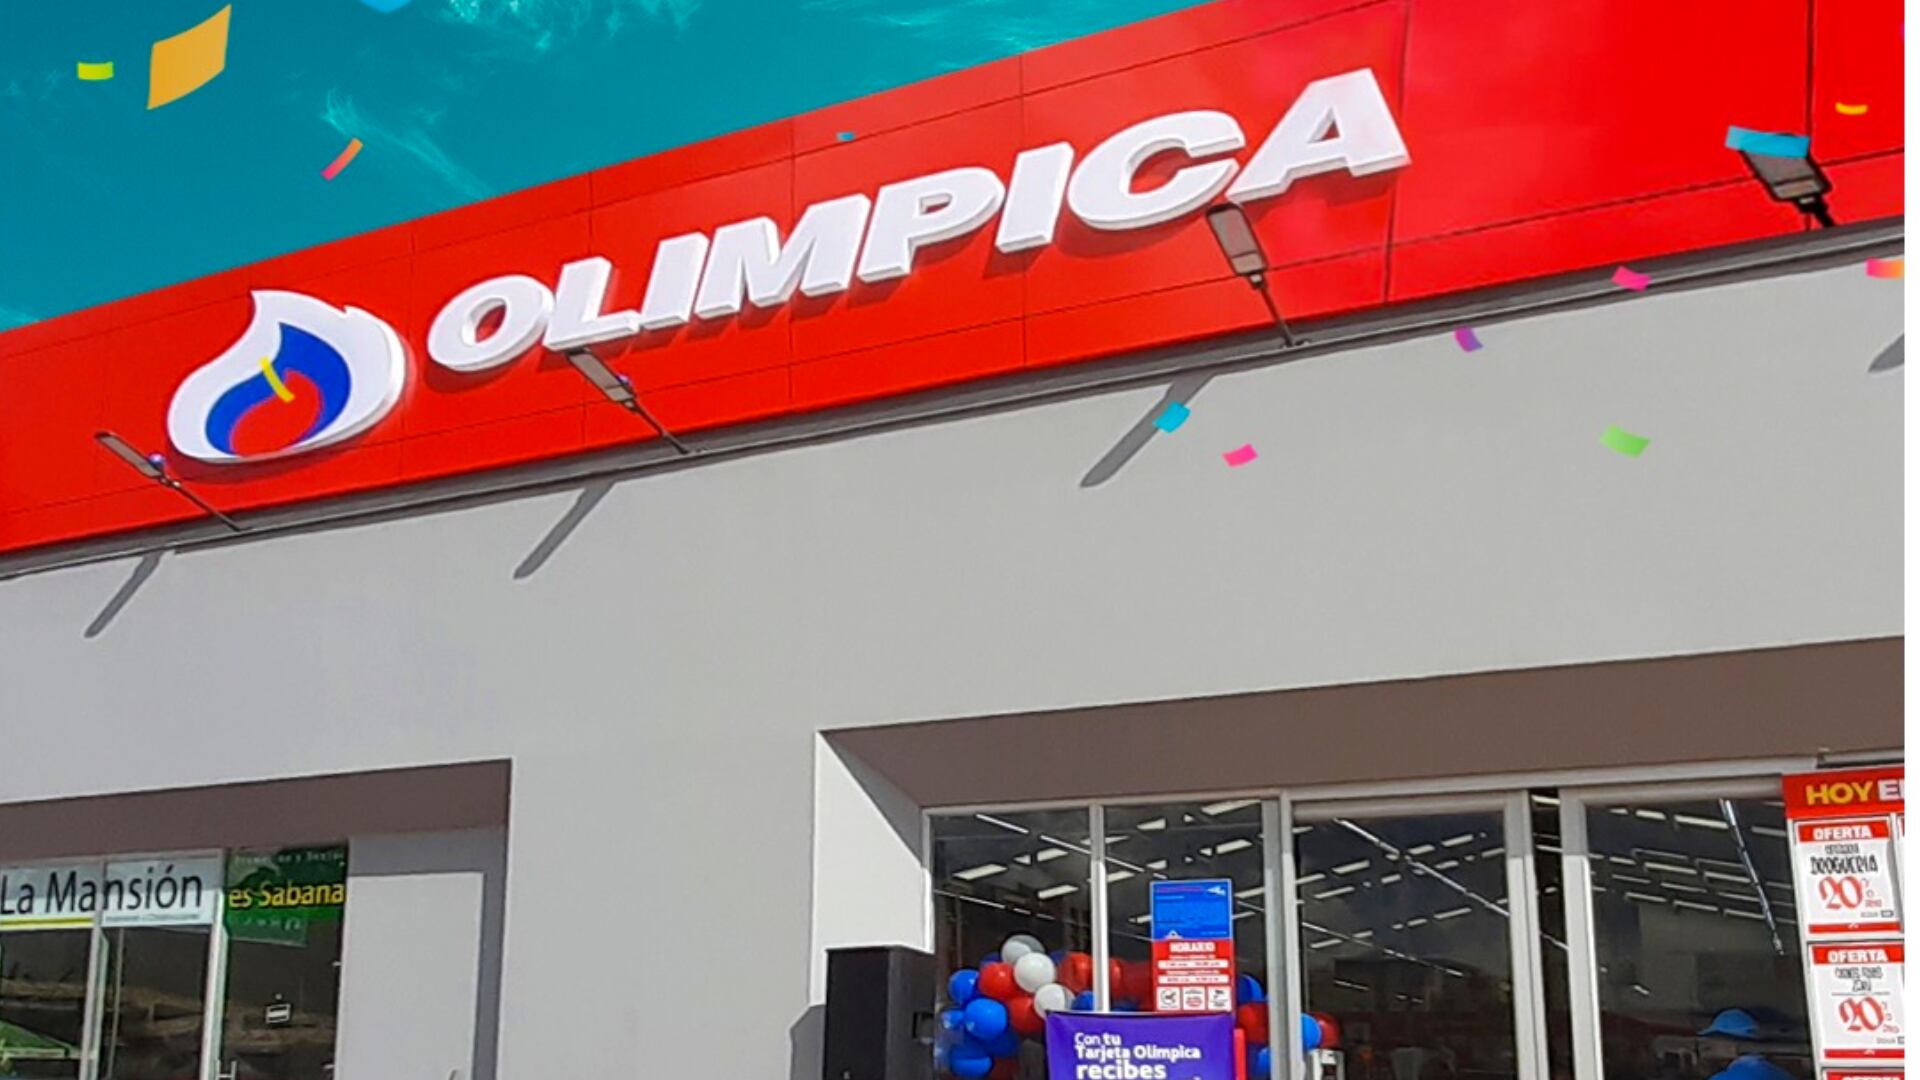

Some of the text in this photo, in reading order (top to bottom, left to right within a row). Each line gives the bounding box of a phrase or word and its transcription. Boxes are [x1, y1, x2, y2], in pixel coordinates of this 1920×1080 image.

[427, 67, 1411, 373] OLIMPICA
[1805, 781, 1873, 805] HOY
[1813, 825, 1873, 840] OFERTA
[0, 864, 202, 915] La Mansión
[257, 880, 345, 907] Sabana
[1827, 949, 1888, 963] OFERTA
[1074, 1032, 1121, 1045] Con tu
[1075, 1044, 1131, 1063] Tarjeta
[1076, 1059, 1167, 1080] recibes
